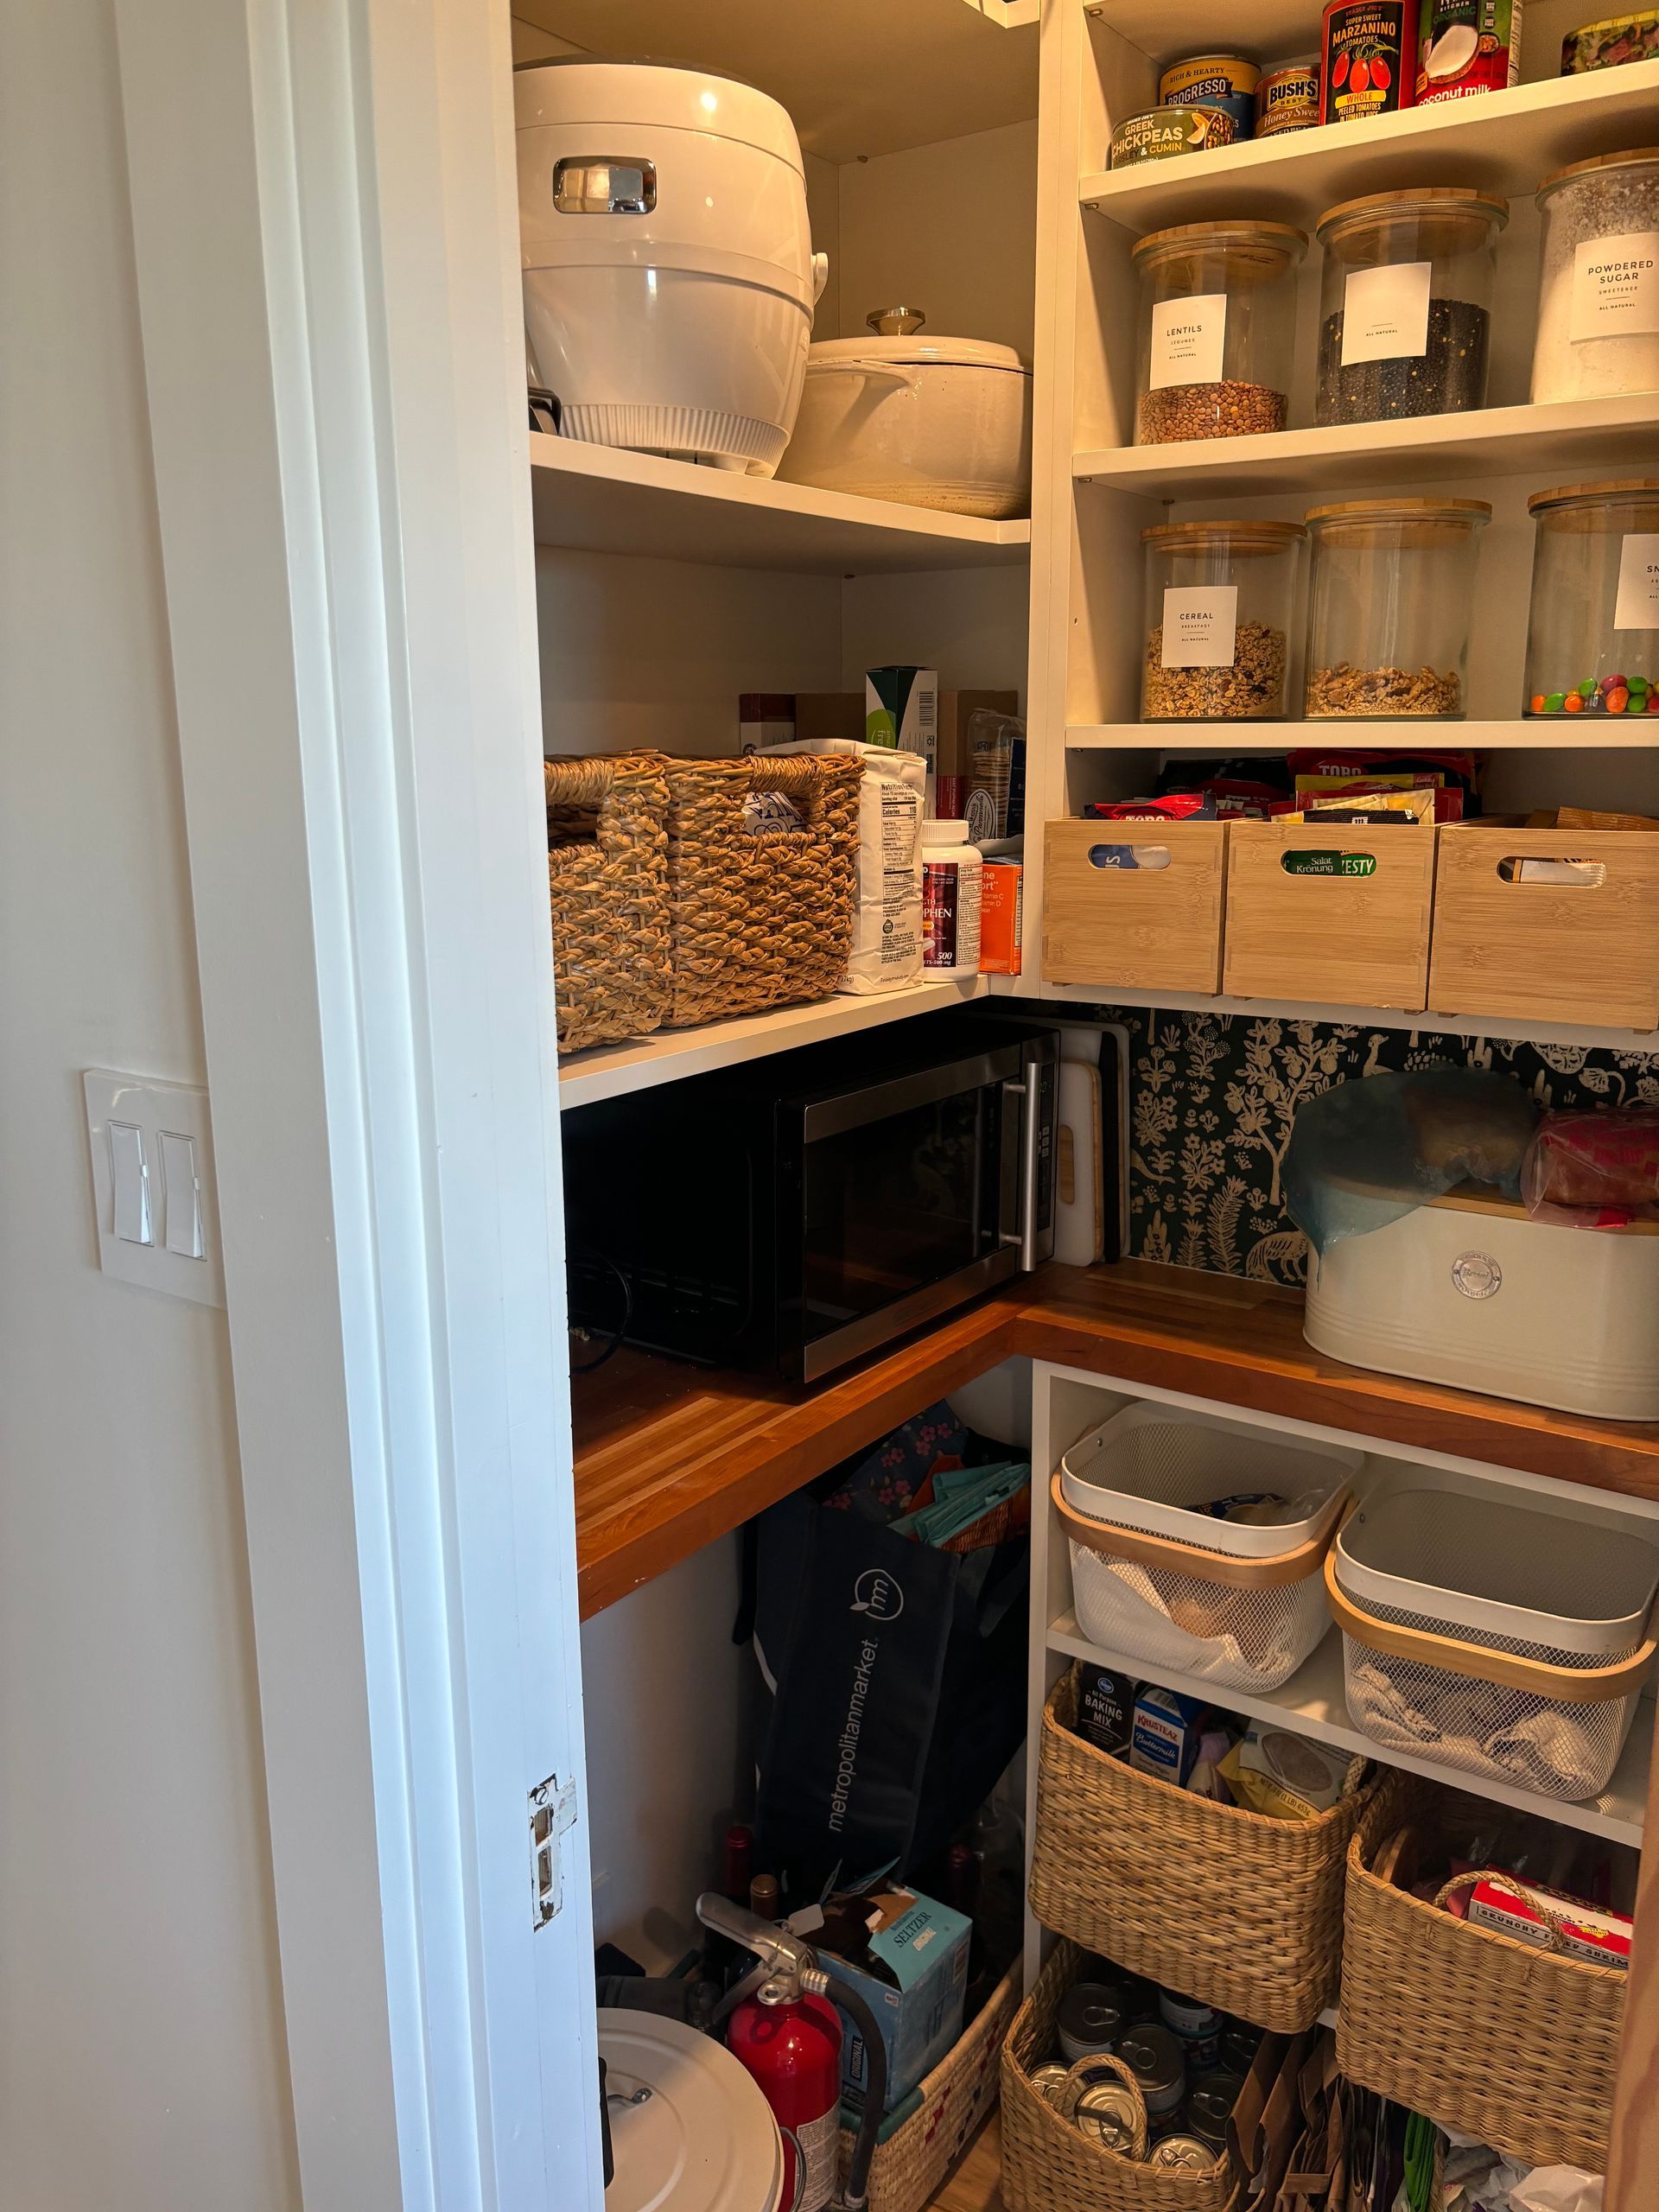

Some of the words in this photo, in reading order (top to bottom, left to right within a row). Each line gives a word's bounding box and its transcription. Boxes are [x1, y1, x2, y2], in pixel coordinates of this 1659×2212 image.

[1345, 16, 1362, 26] SUPER
[1363, 13, 1382, 22] SWEET
[1433, 6, 1476, 24] ORGANIC
[1332, 22, 1395, 47] MARZANINO
[1345, 35, 1379, 48] TOMATOES
[1169, 73, 1185, 84] RICH
[1193, 67, 1225, 76] HEARTY
[1167, 79, 1226, 105] PROGRESSO
[1269, 80, 1316, 105] BUSH'S
[1347, 92, 1373, 104] WHOLE
[1465, 84, 1491, 97] milk
[1280, 97, 1302, 105] BEST
[1338, 104, 1355, 116] PEELED
[1356, 102, 1382, 112] TOMATOES
[1264, 111, 1293, 127] Honey
[1125, 119, 1155, 136] GREEK
[1112, 126, 1184, 158] CHICKPEAS
[1140, 146, 1148, 156] &
[1149, 142, 1183, 155] CUMIN
[1587, 260, 1654, 276] POWDERED
[1599, 272, 1640, 284] SUGAR
[1166, 325, 1202, 337] LENTILS
[1296, 864, 1334, 874] Krönung
[1310, 856, 1333, 866] Salat
[1084, 1694, 1123, 1720] BAKING
[1093, 1711, 1112, 1728] MIX
[828, 1639, 879, 1832] metropolitanmarket
[1137, 1714, 1179, 1742] KRUSTEAZ
[1135, 1732, 1176, 1759] Buttermilk
[893, 1911, 933, 1948] SELTZER
